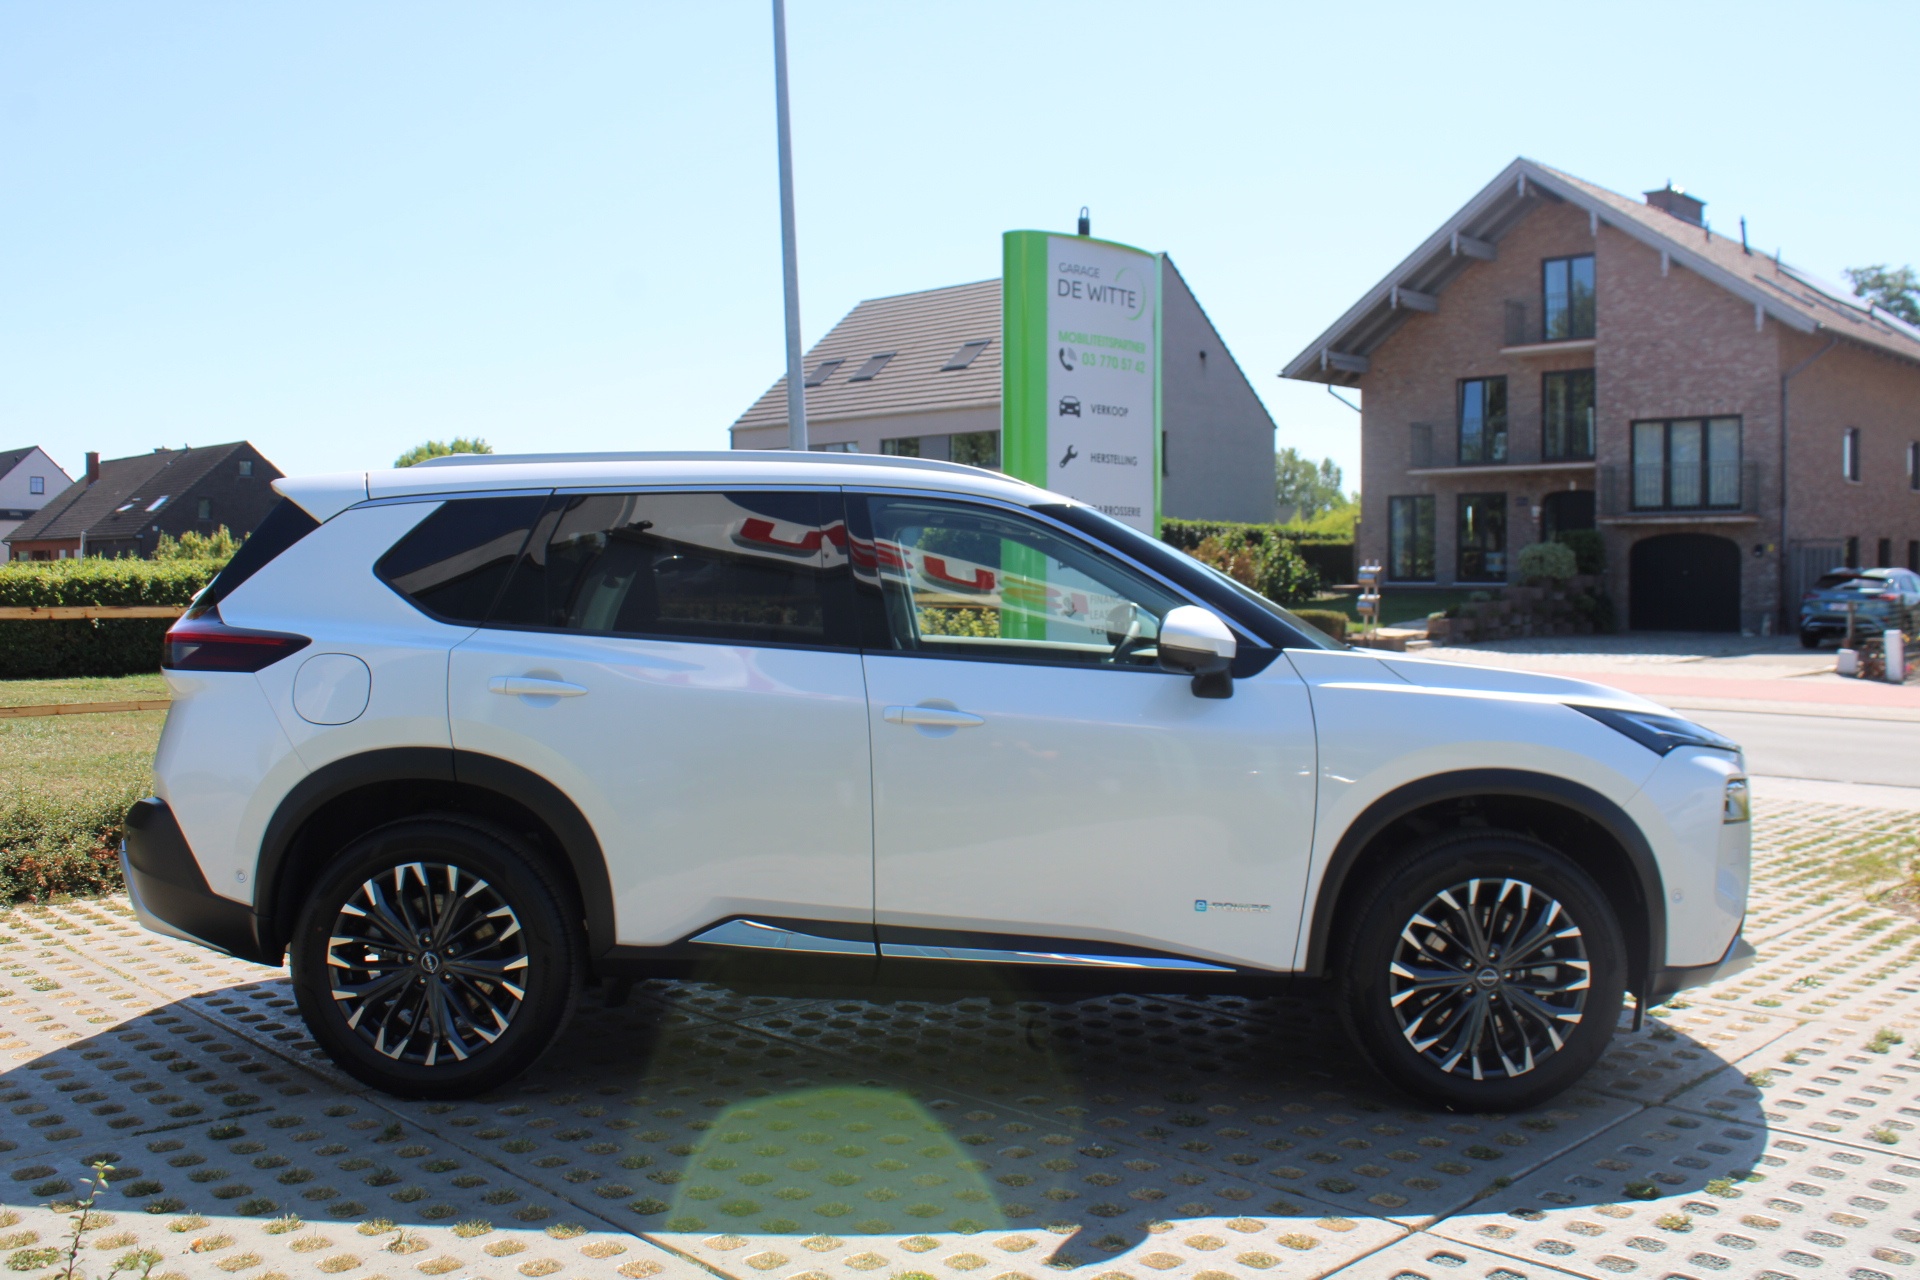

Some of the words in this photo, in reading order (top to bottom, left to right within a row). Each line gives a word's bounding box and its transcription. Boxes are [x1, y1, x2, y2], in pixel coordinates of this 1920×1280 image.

[1058, 262, 1100, 279] GARAGE
[1057, 278, 1082, 299] DE
[1086, 282, 1137, 309] WITTE
[1082, 351, 1097, 367] 03
[1100, 354, 1119, 370] 770
[1090, 403, 1129, 418] VERKOOP
[1090, 453, 1138, 467] HERSTELLING
